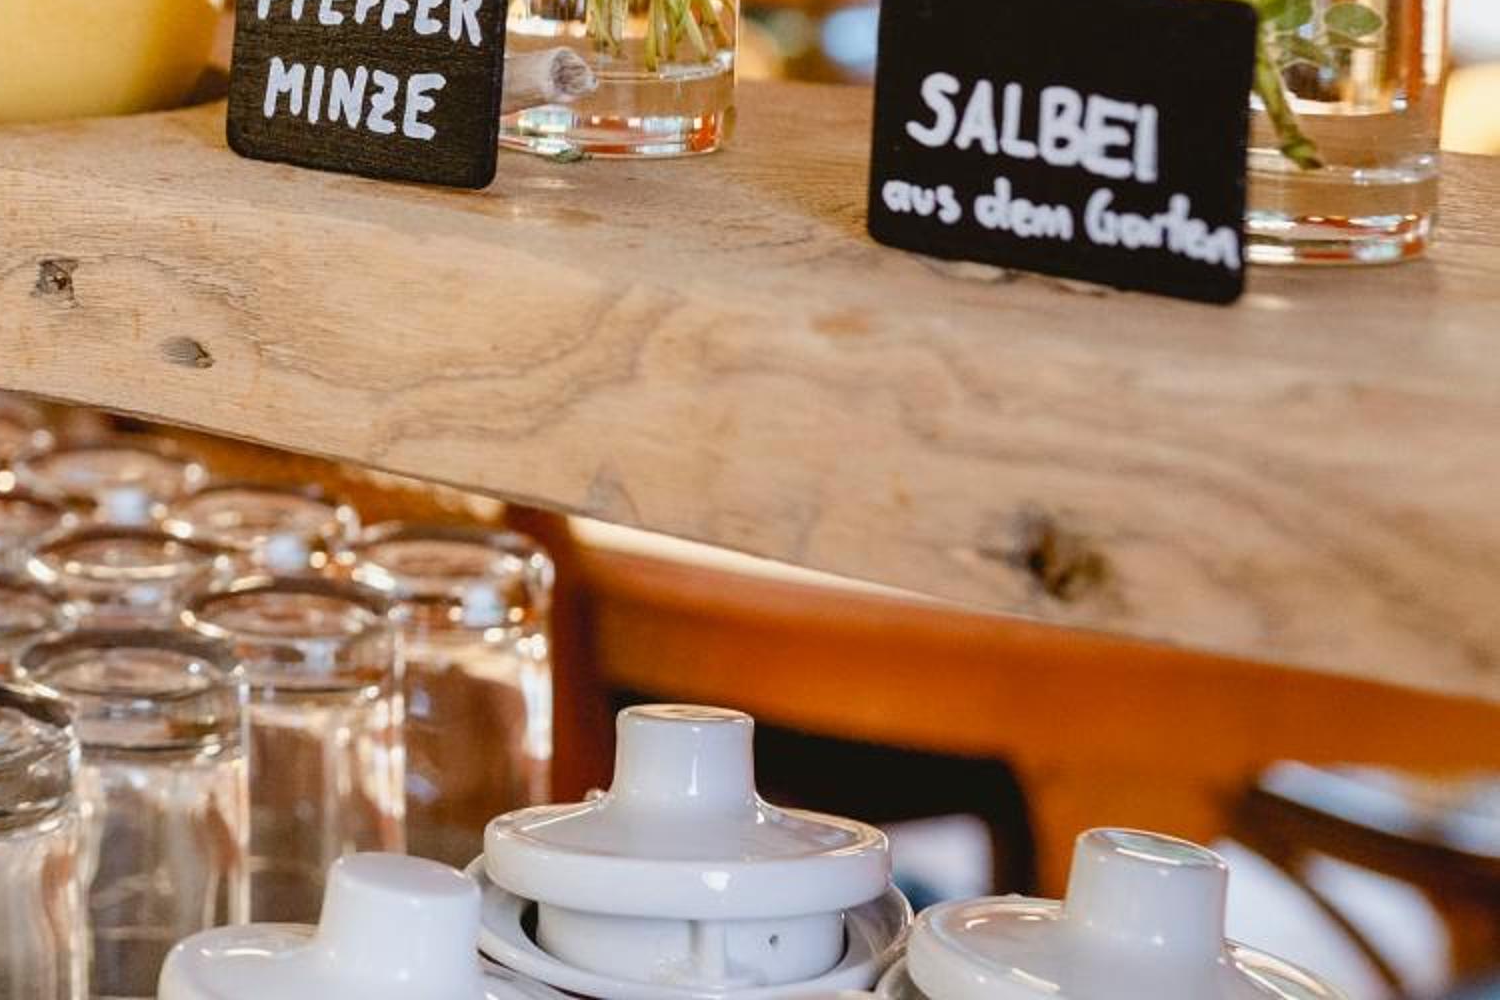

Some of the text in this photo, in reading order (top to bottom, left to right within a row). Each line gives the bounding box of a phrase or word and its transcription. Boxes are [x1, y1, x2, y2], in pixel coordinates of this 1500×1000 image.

[263, 56, 447, 141] MINZE
[906, 72, 1159, 183] SALBEI
[882, 177, 1241, 269] aus dem Garten
